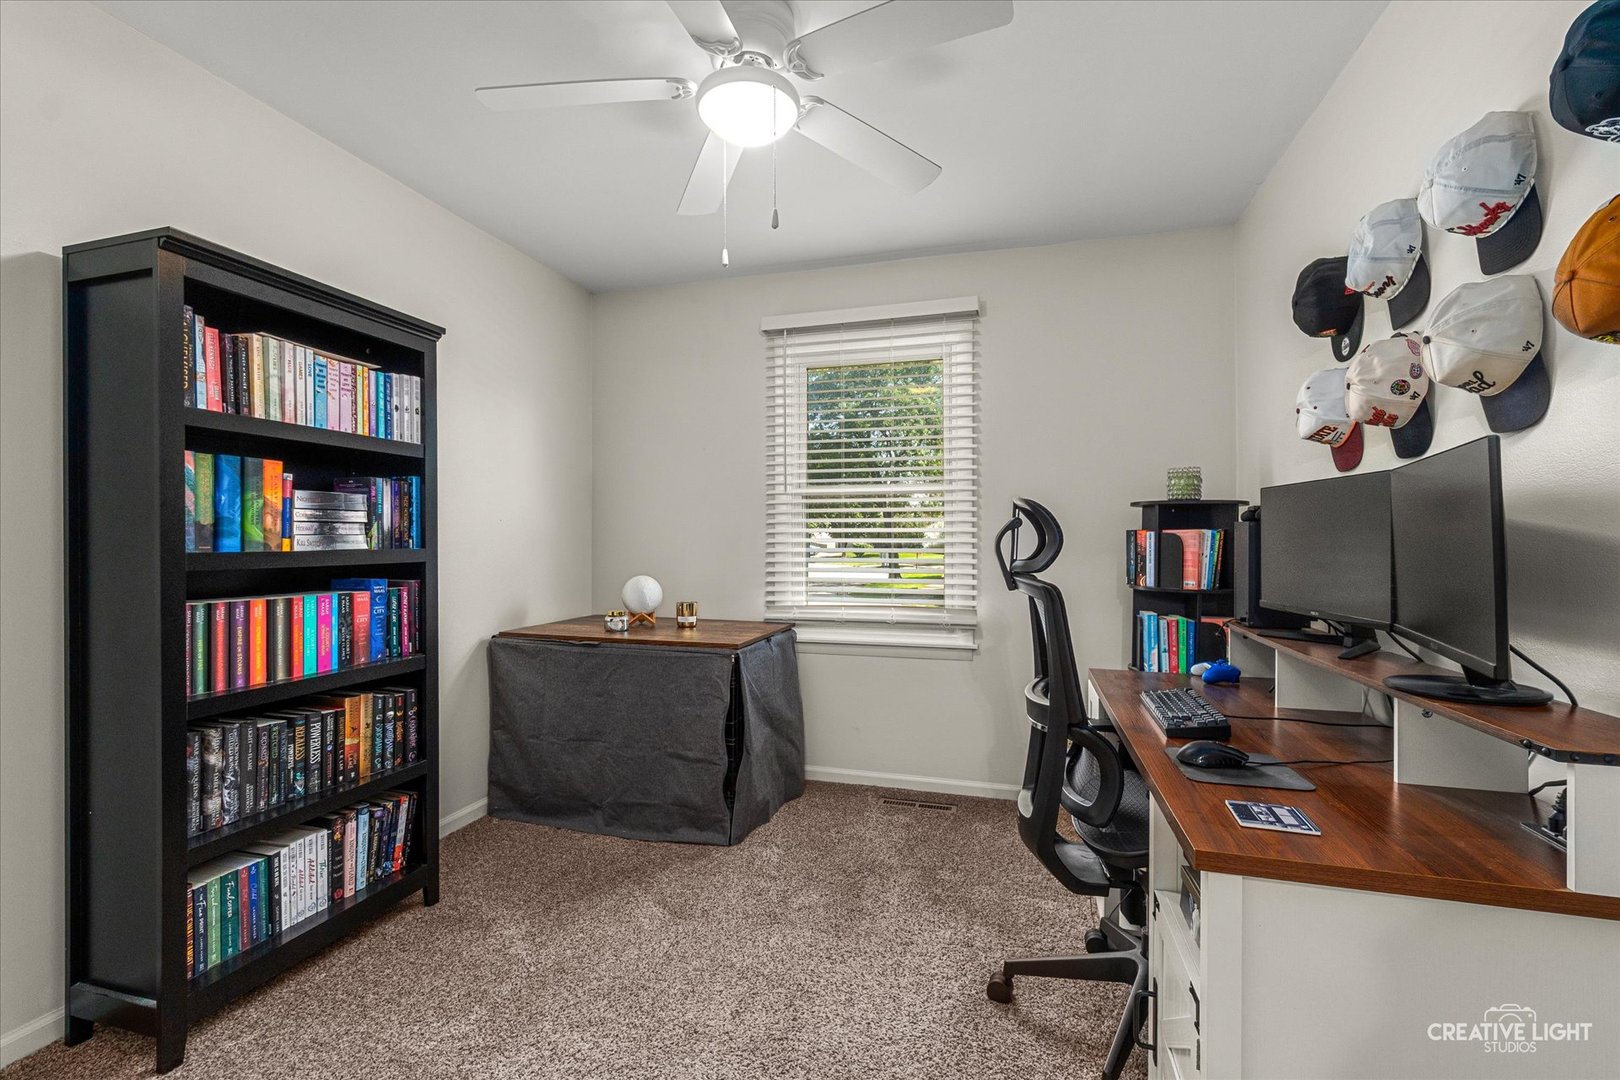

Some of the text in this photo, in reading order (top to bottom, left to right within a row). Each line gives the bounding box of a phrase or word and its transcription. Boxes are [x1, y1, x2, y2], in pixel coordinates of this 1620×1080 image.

[295, 726, 305, 760] RECKLESS
[310, 722, 321, 764] POWERLESS
[307, 858, 315, 884] Addicted
[225, 880, 235, 899] Final
